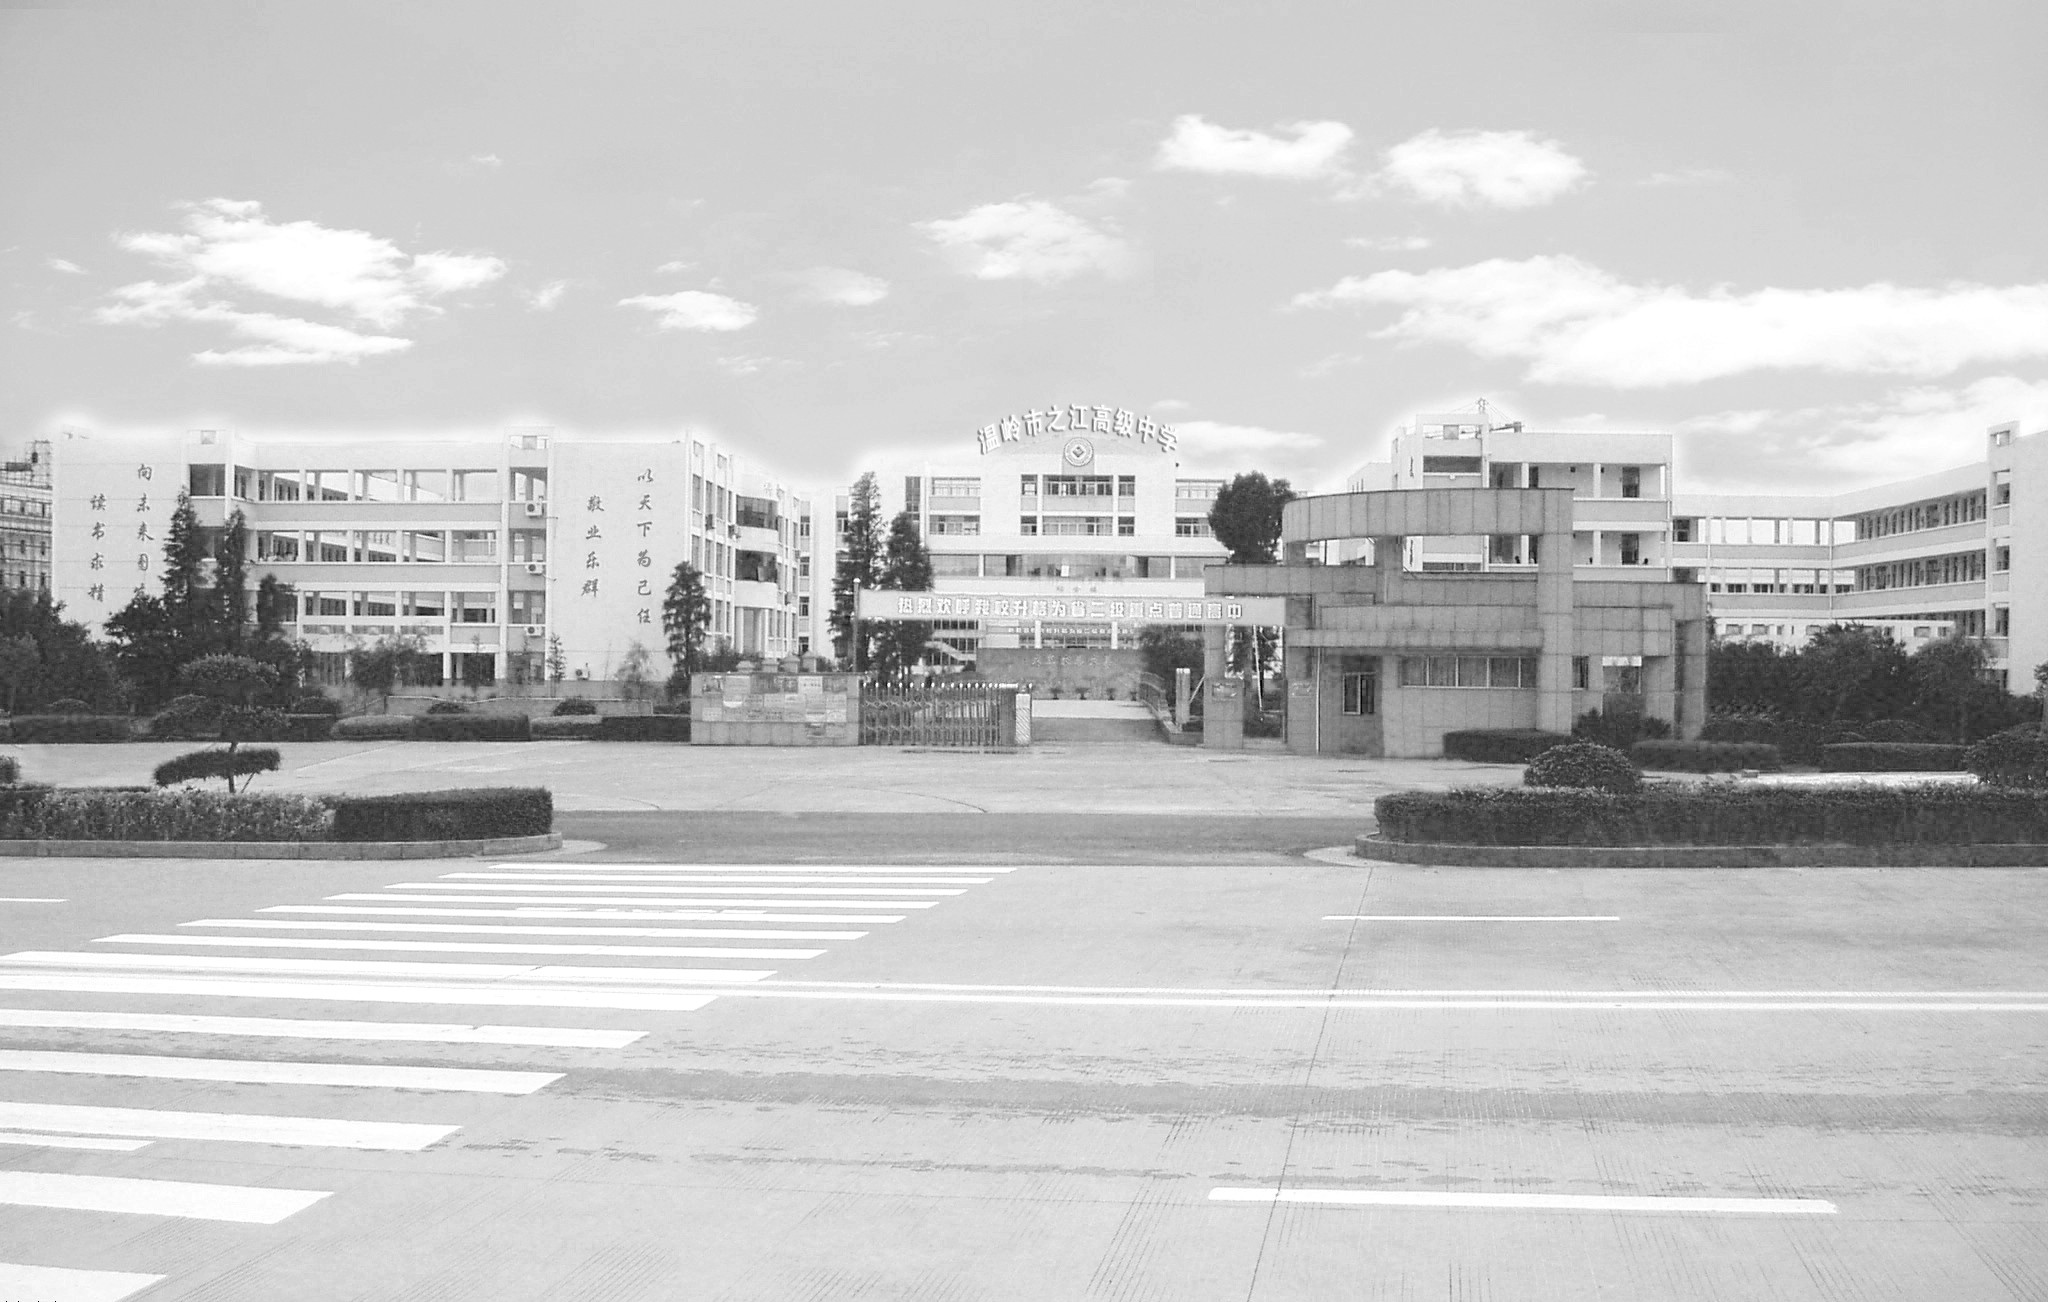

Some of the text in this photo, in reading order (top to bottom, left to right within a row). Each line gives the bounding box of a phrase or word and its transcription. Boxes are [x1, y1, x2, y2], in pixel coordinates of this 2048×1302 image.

[977, 403, 1179, 455] 温岭市之江高级中学
[88, 493, 106, 602] 读书求精
[581, 495, 604, 598] 敬业乐群
[637, 468, 654, 624] 以天下为己任
[899, 598, 1243, 619] 热烈欢呼我校升格为省二级重点普通高中
